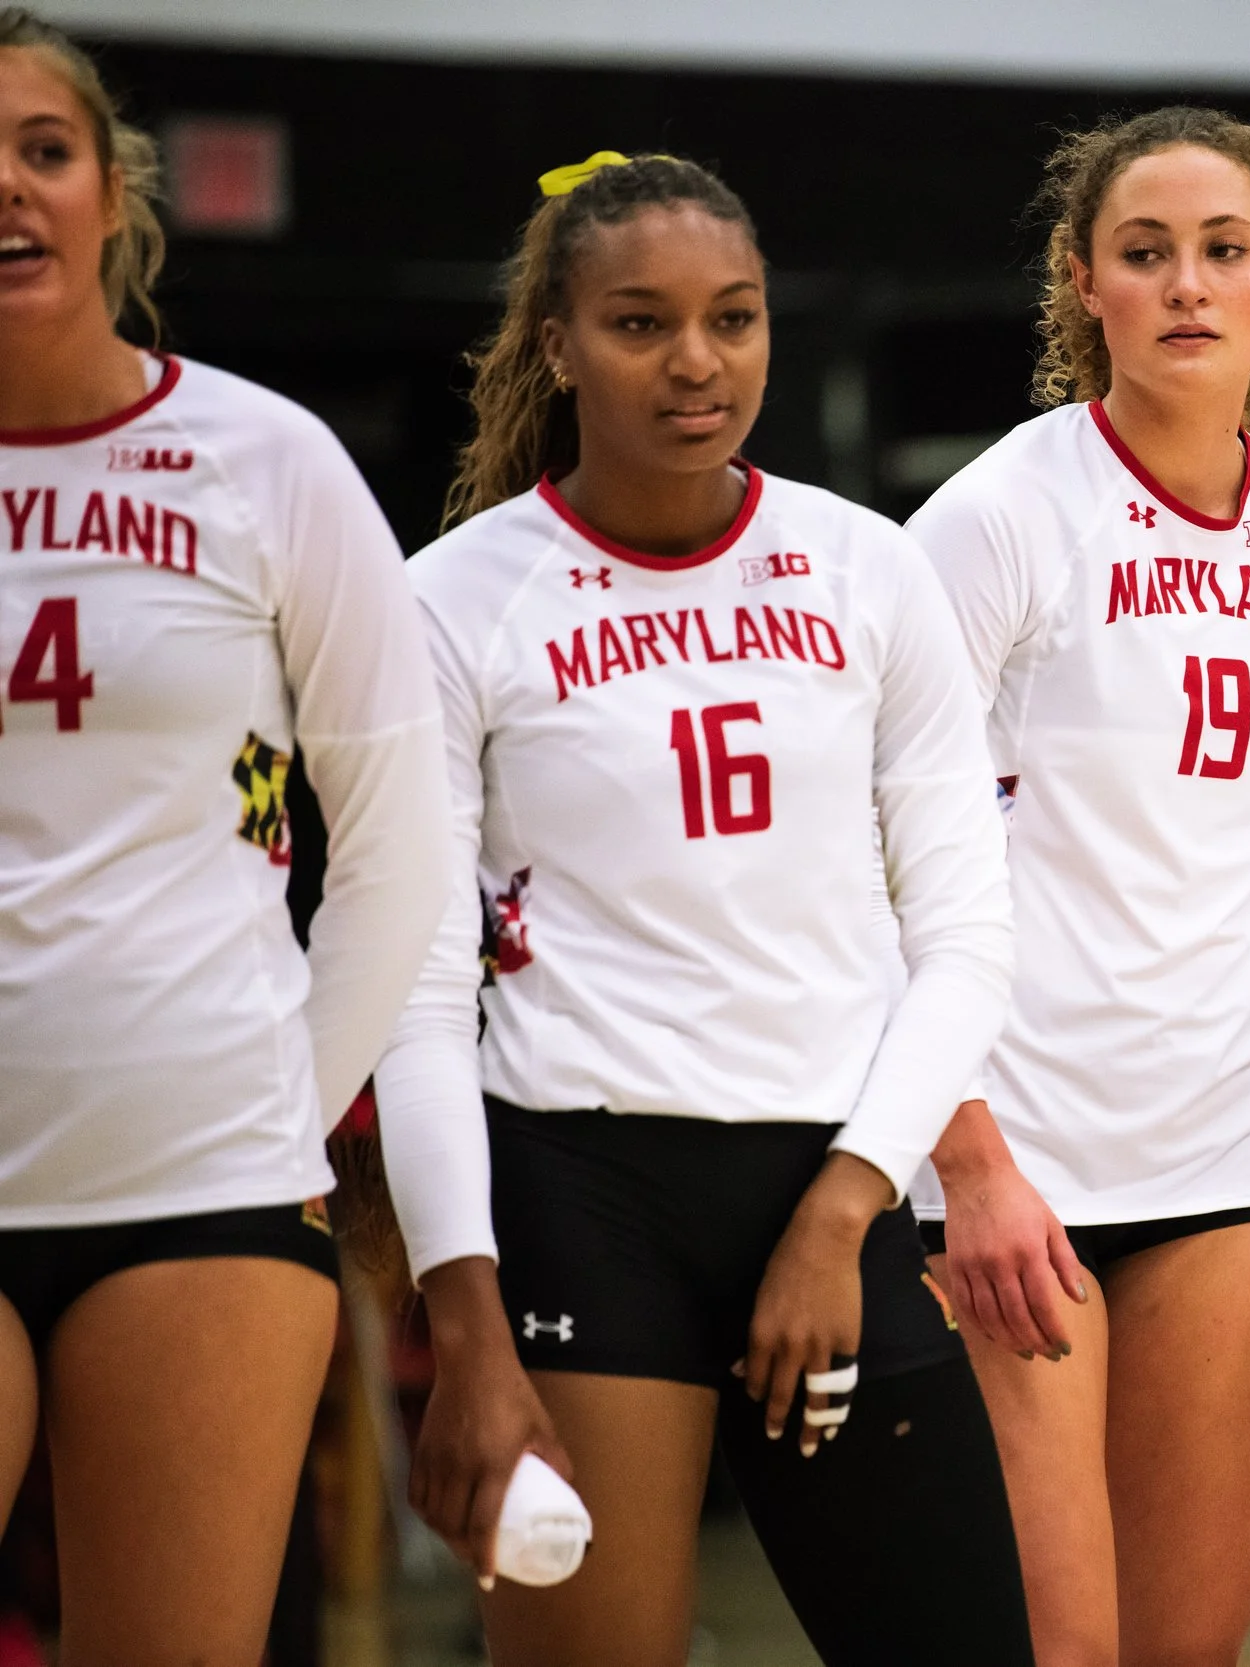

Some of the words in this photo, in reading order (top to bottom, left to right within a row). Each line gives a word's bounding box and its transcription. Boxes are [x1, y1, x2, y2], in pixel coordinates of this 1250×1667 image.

[1, 487, 198, 577] YLAND
[0, 597, 94, 737] 4
[545, 604, 846, 703] MARYLAND
[670, 700, 772, 839] 16
